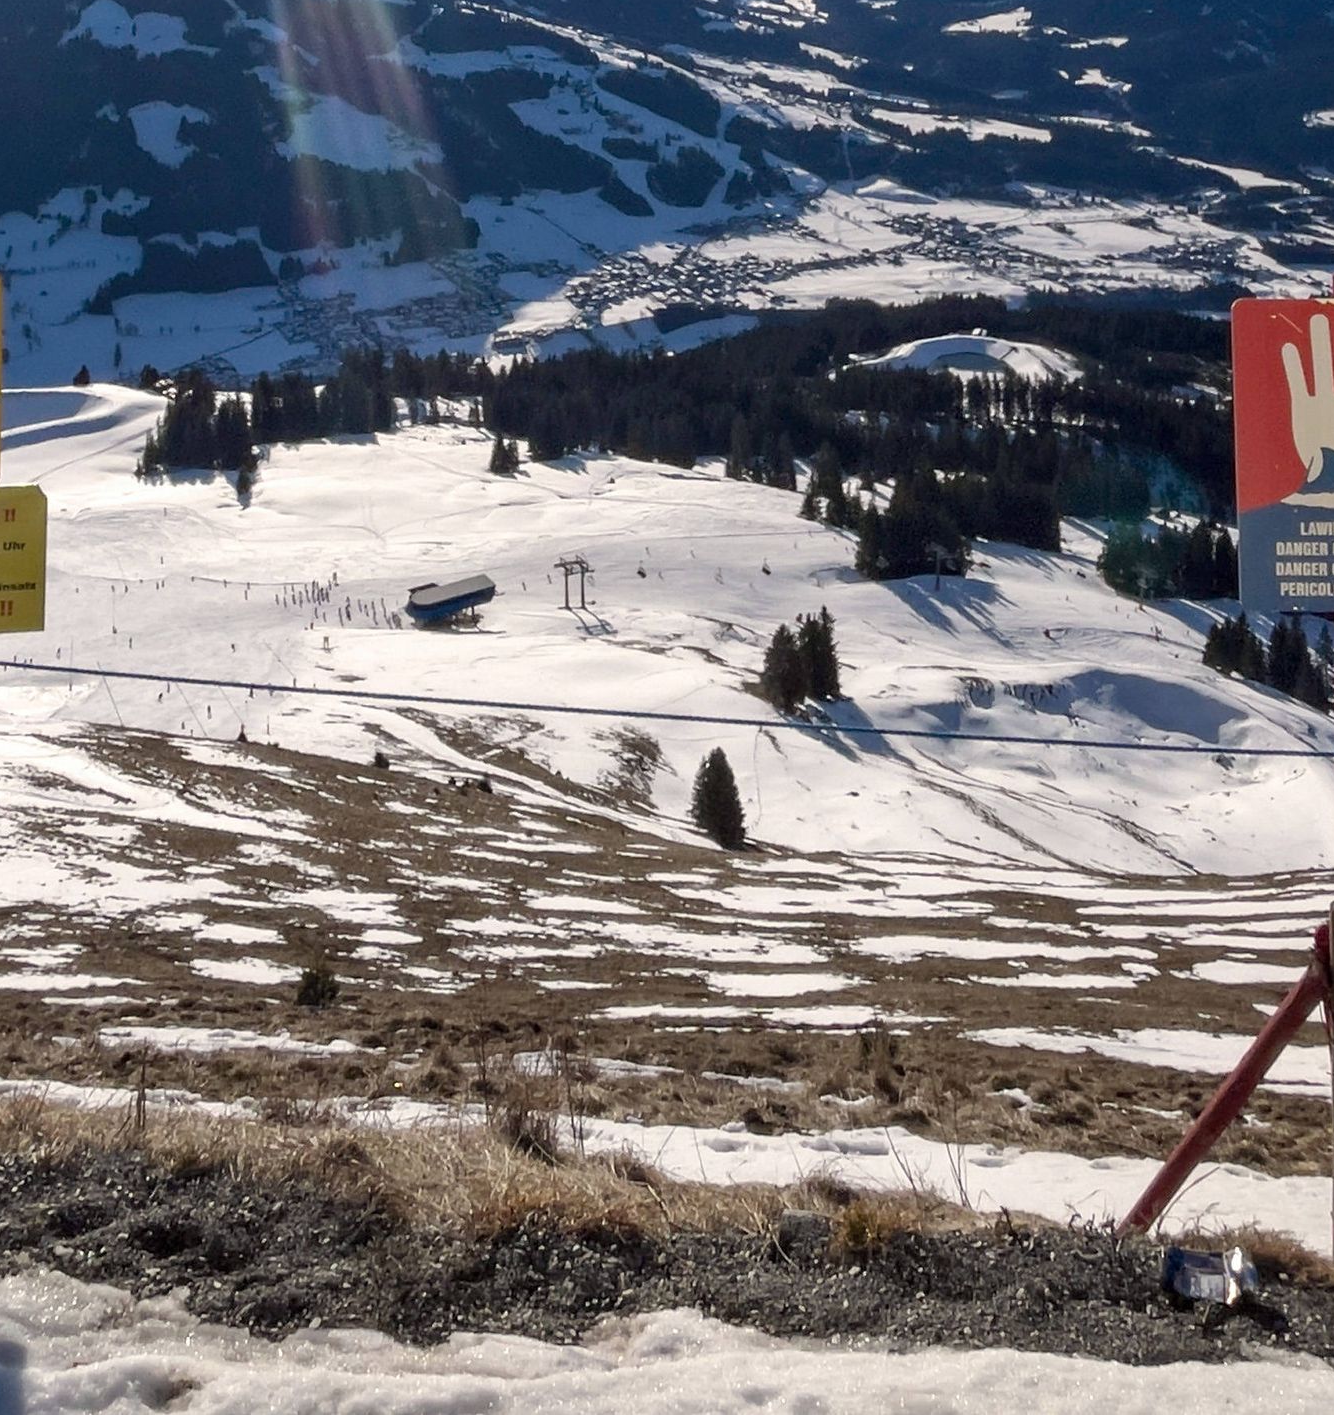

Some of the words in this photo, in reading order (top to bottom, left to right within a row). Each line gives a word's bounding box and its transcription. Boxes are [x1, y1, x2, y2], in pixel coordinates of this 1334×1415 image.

[3, 541, 26, 551] Uhr
[1275, 542, 1329, 556] DANGER
[1275, 562, 1328, 576] DANGER
